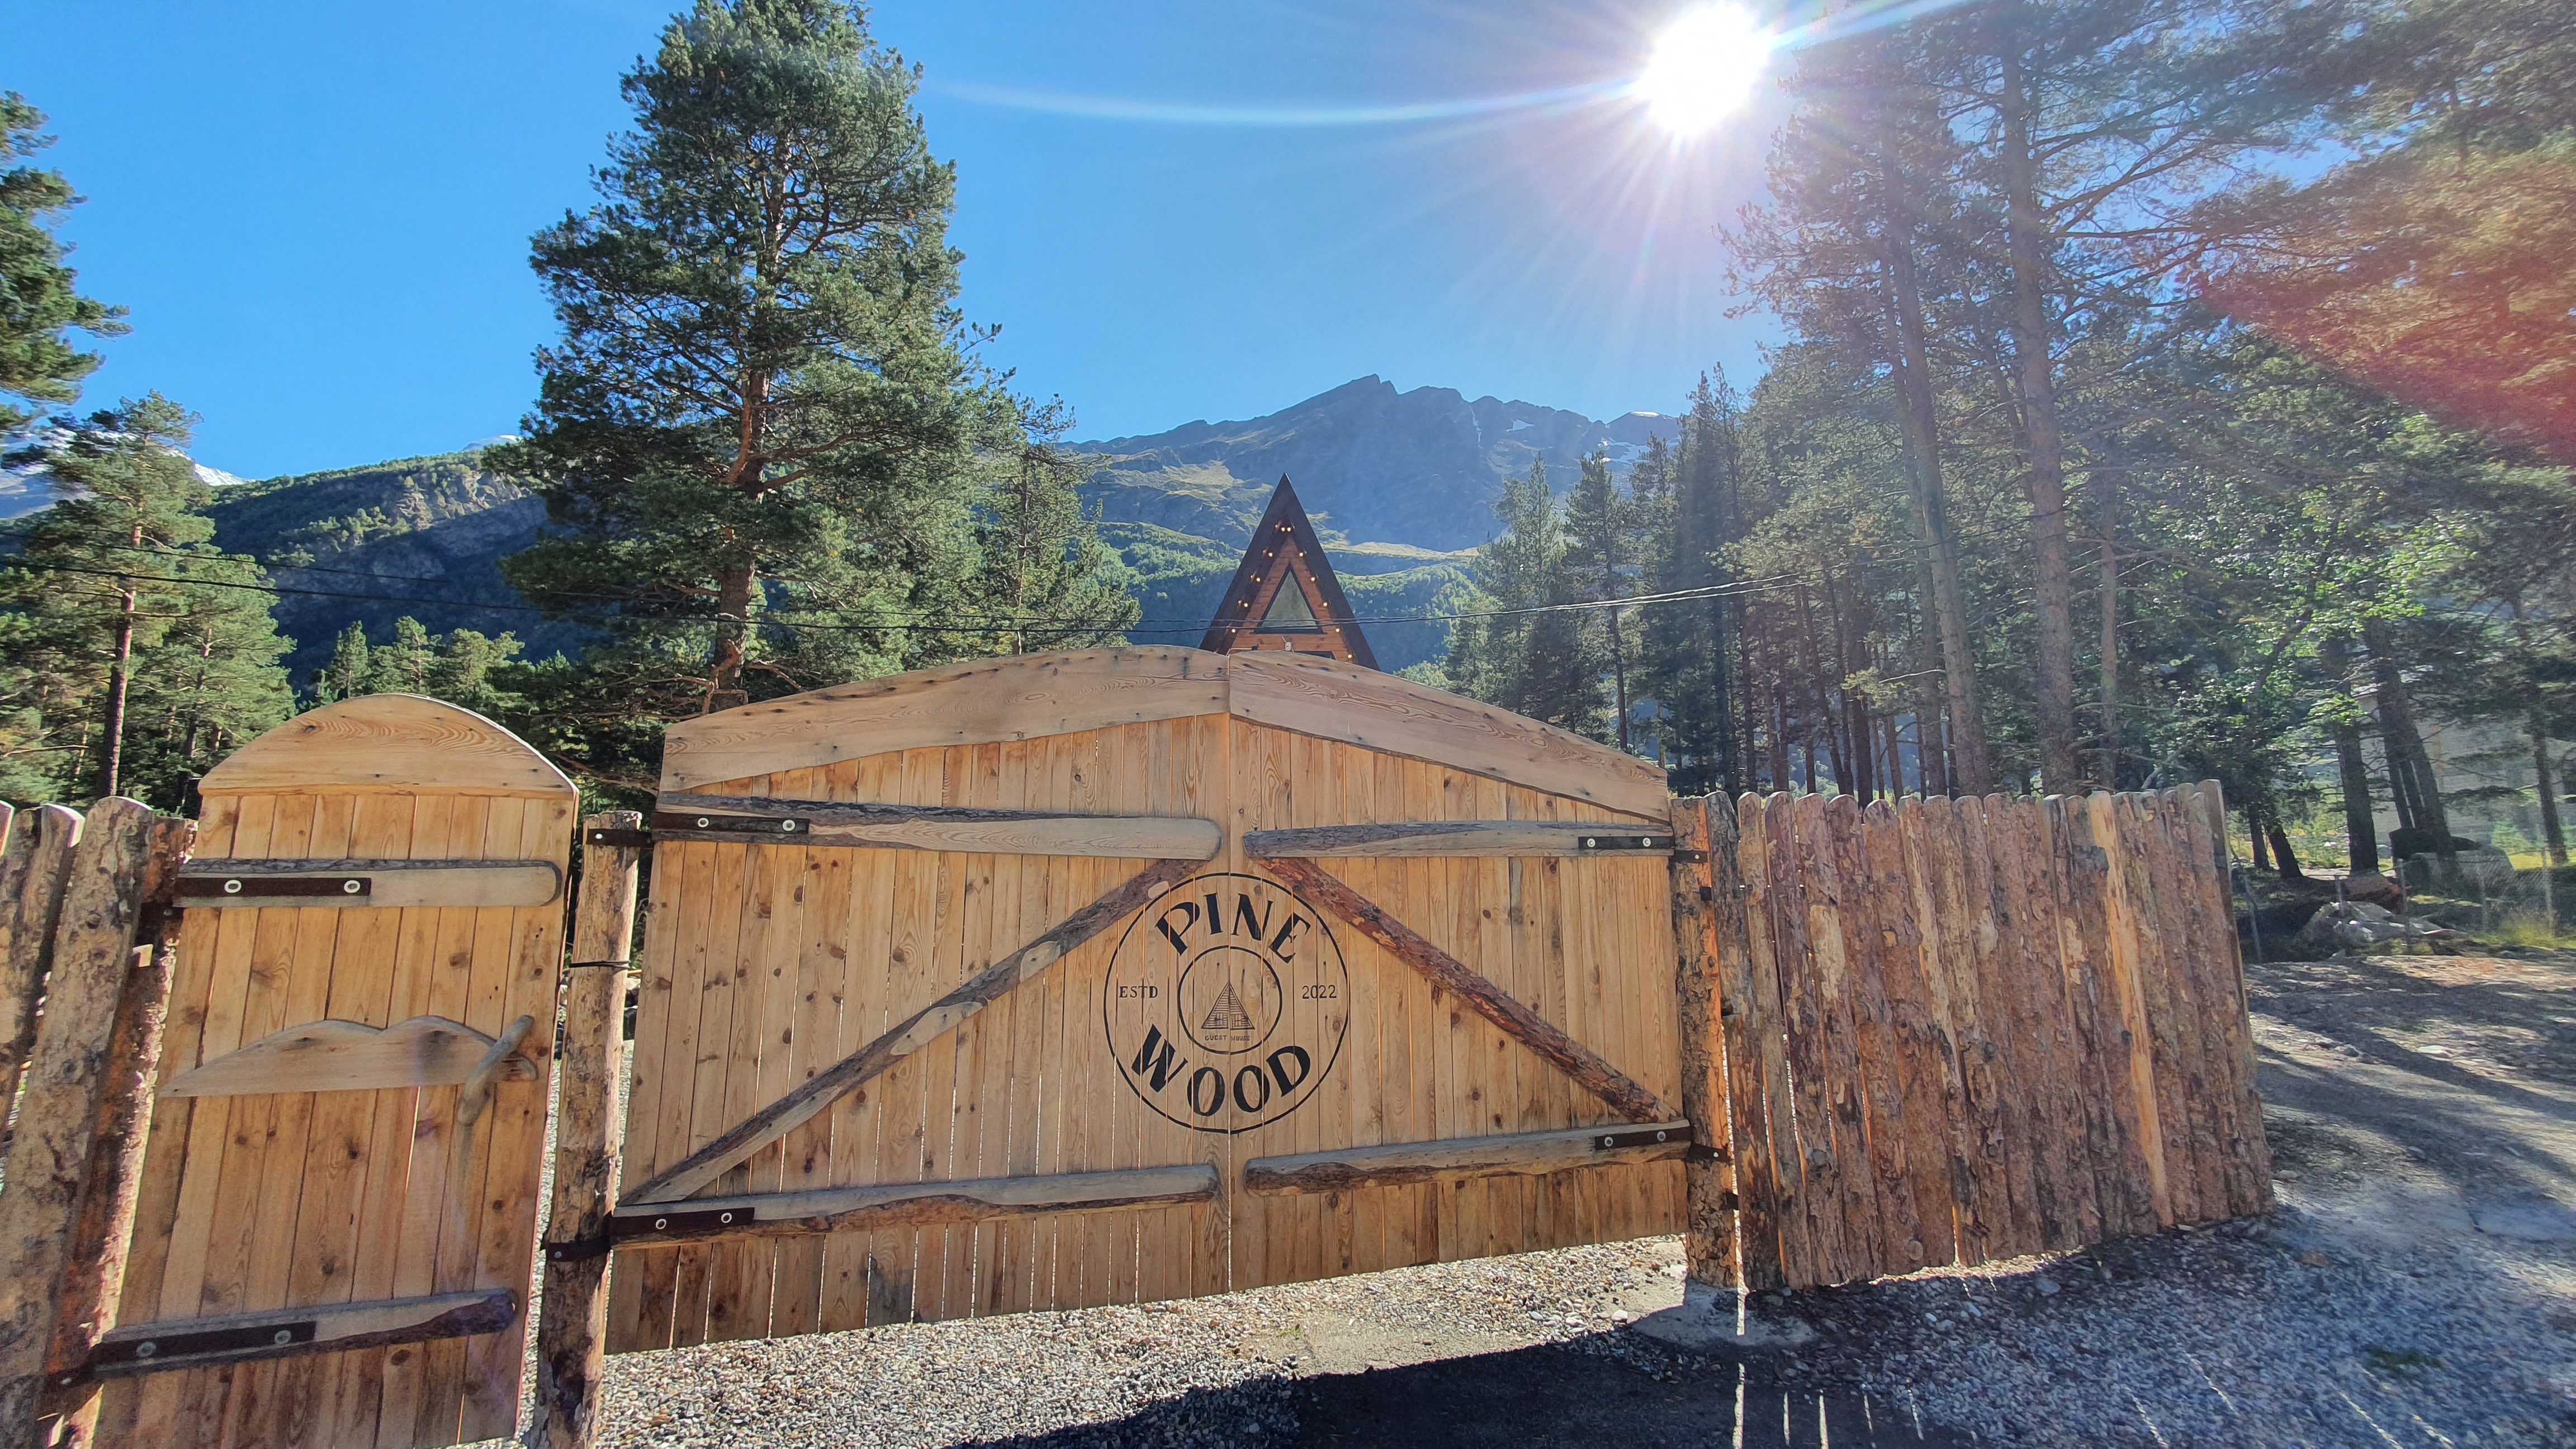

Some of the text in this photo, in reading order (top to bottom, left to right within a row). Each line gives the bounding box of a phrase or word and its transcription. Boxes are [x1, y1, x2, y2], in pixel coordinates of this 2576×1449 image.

[1154, 892, 1311, 964] PINE
[1119, 984, 1337, 1000] ESTD 2022
[1131, 1024, 1311, 1116] WOOD
